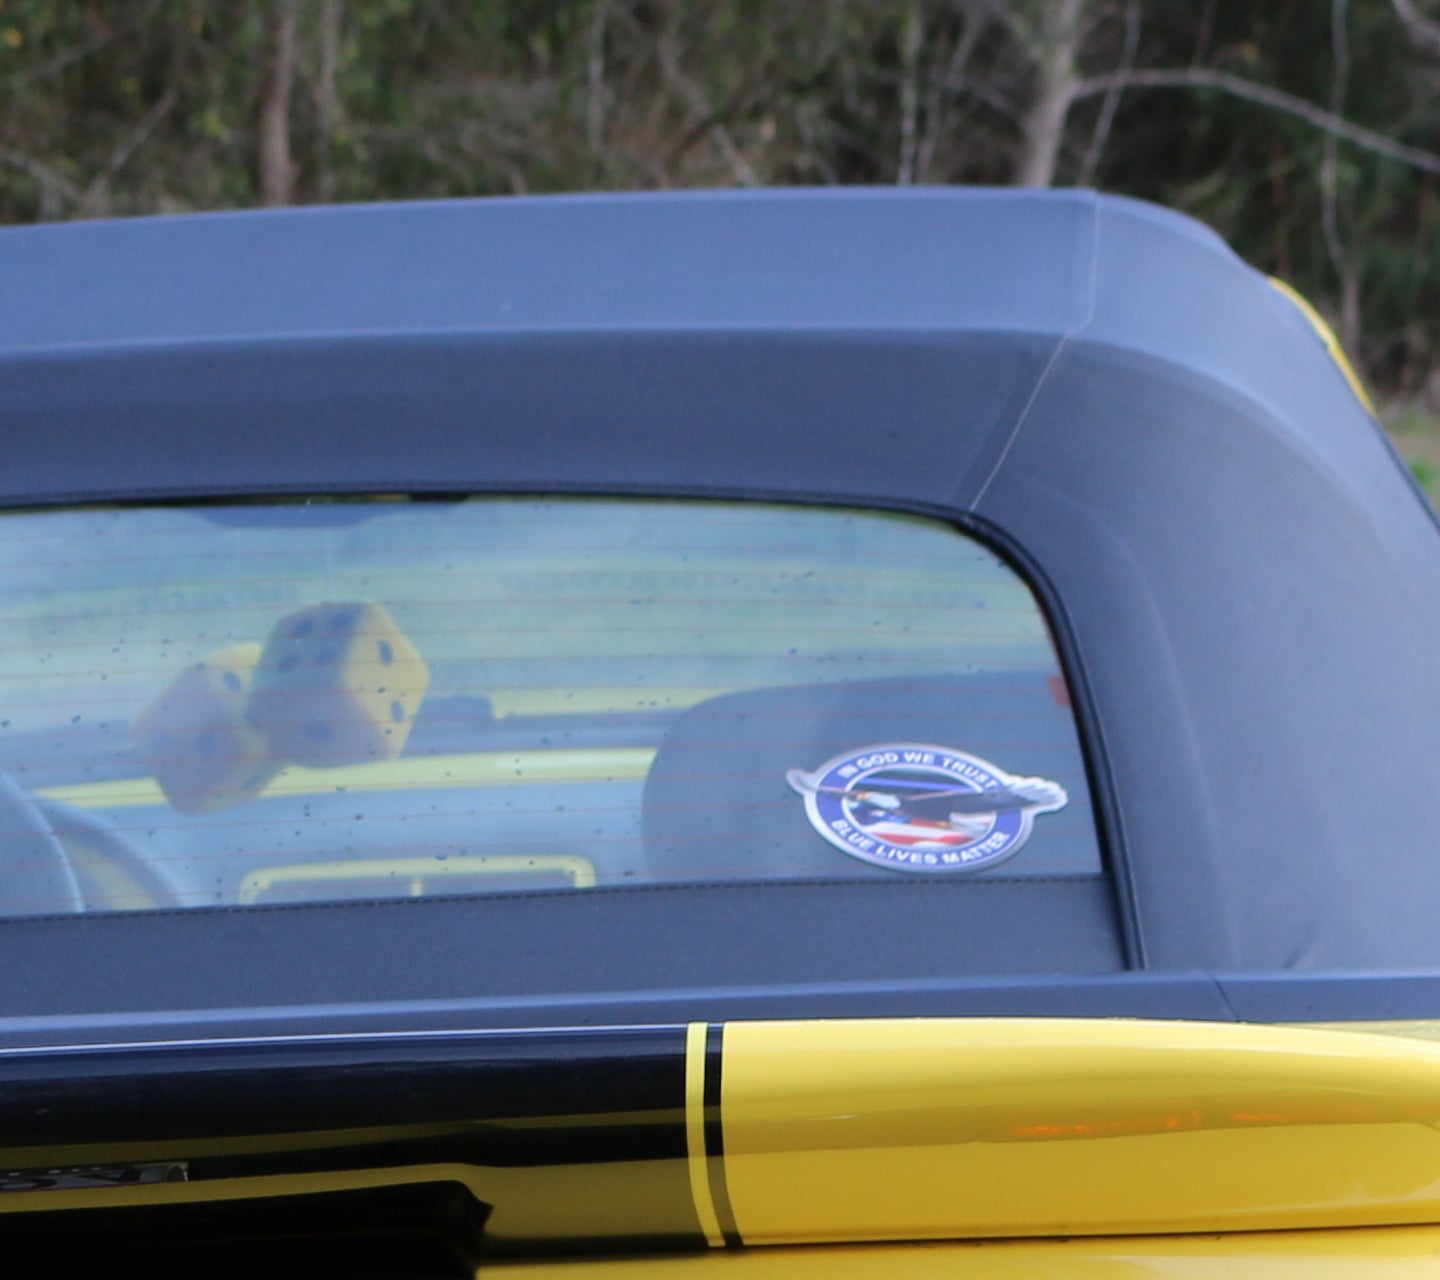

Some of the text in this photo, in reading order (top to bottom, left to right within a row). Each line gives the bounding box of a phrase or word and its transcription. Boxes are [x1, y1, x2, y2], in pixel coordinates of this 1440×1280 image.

[857, 752, 898, 768] GOD
[904, 752, 935, 764] WE
[943, 758, 998, 789] TRUST
[832, 819, 1010, 864] BLUE LIVES MATTER
